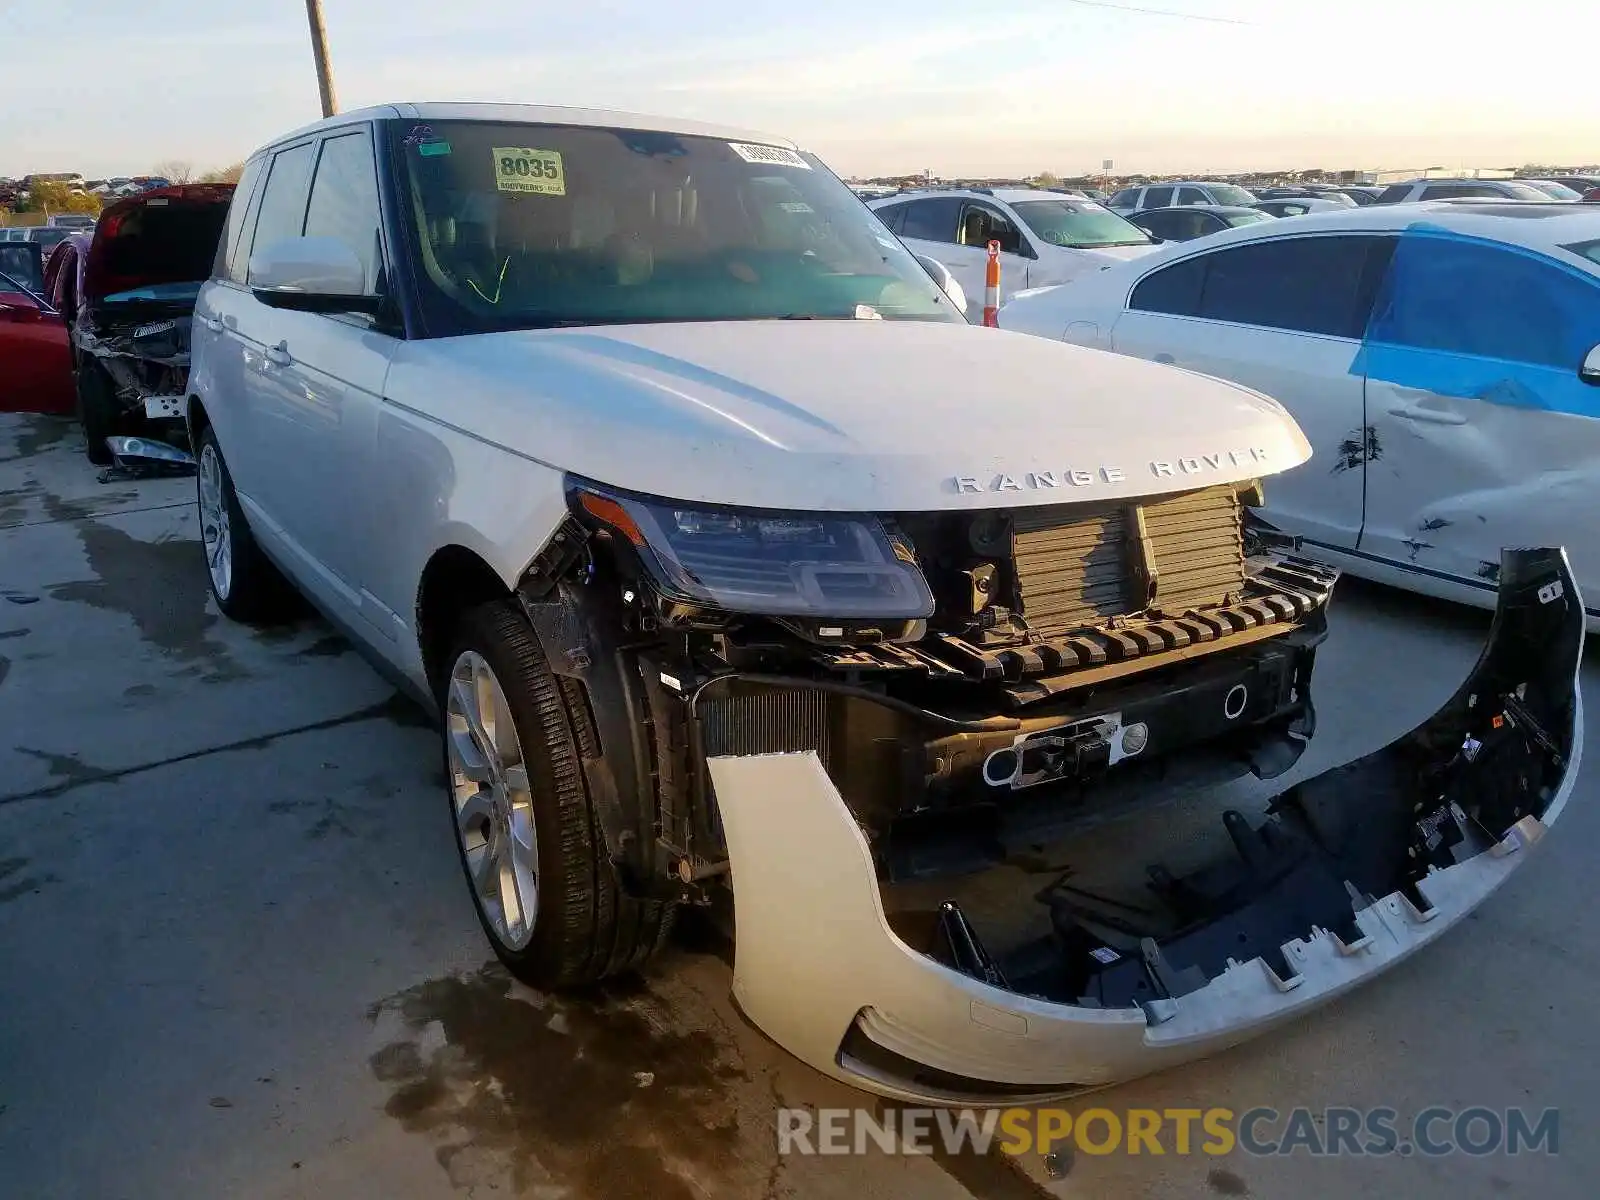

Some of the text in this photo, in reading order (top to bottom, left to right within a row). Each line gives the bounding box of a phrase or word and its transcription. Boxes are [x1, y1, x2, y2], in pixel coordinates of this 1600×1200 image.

[500, 157, 558, 179] 8035
[954, 447, 1268, 495] RANGE ROVER
